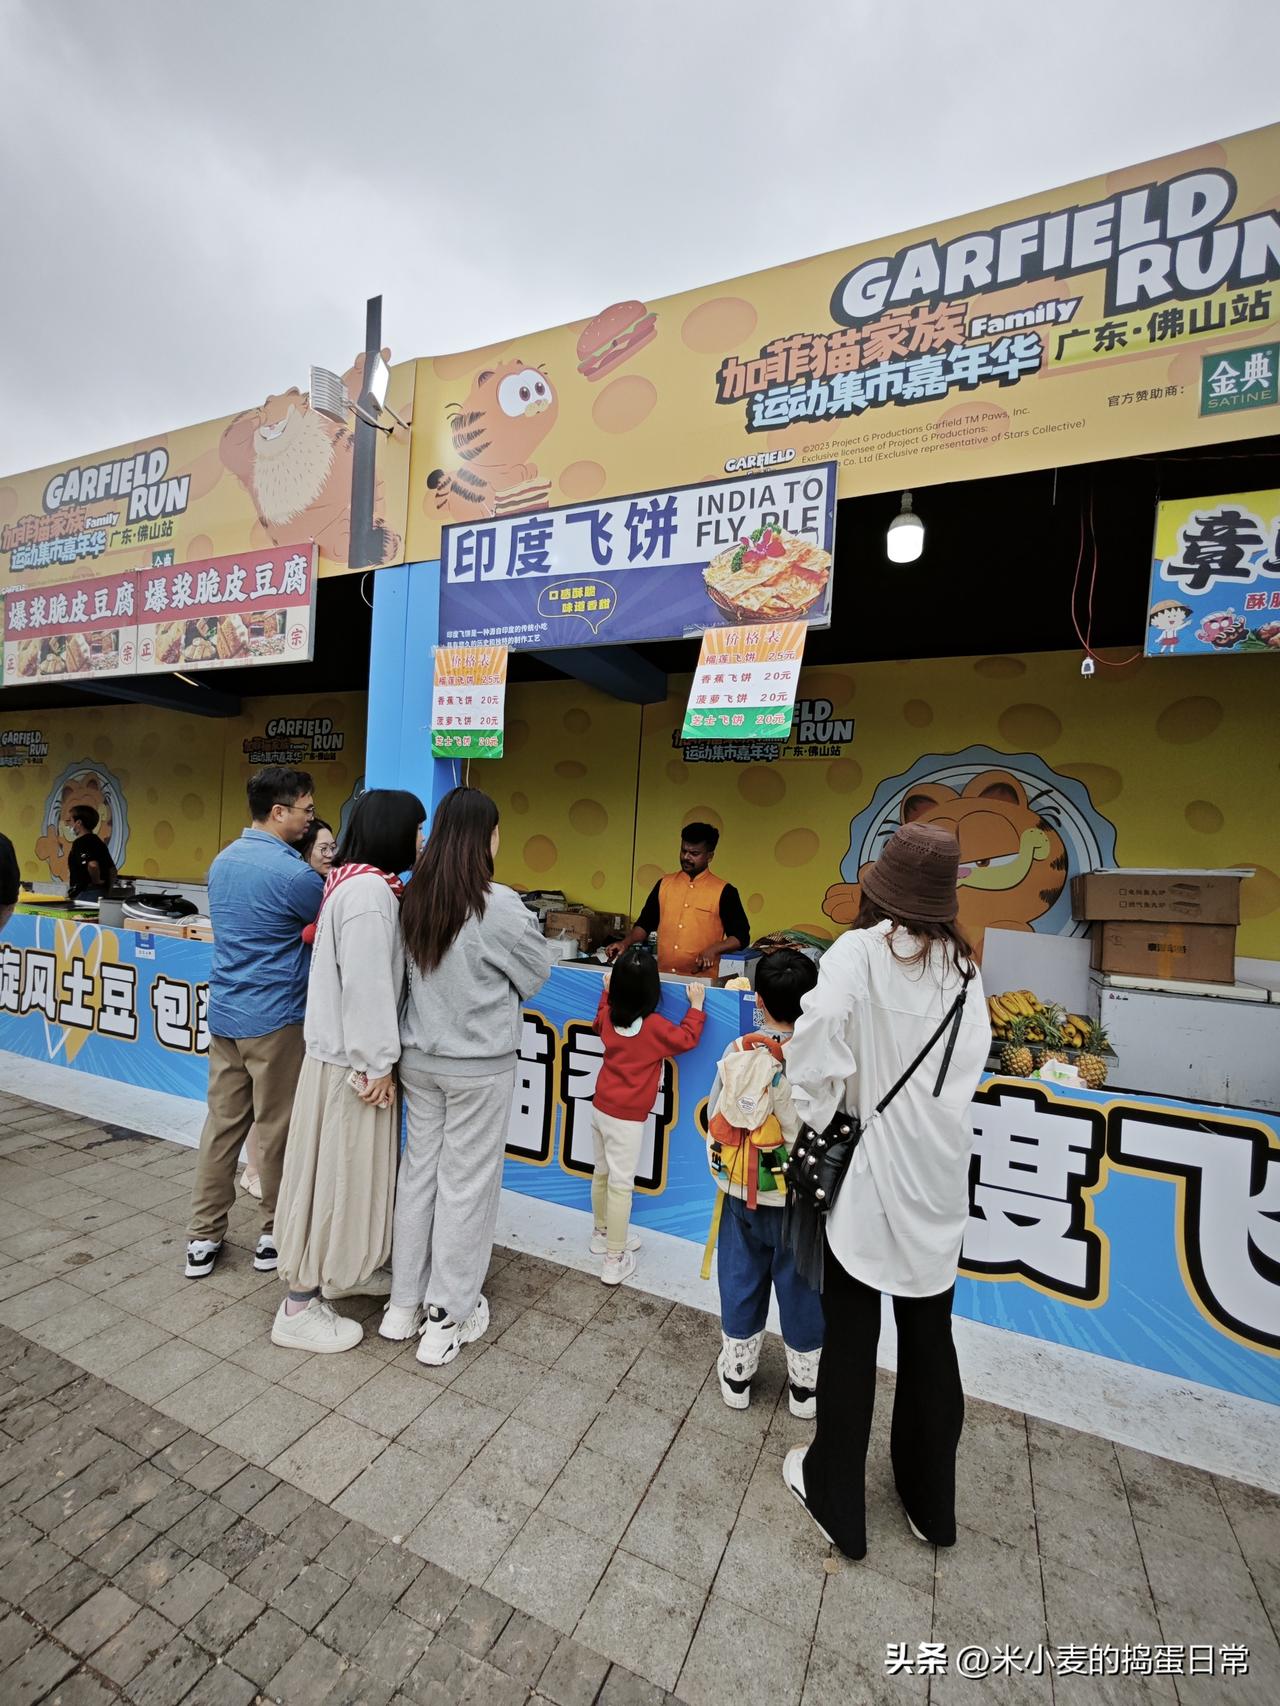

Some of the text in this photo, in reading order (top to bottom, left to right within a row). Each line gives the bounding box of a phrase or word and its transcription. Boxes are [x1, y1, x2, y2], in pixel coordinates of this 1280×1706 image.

[833, 169, 1236, 323] GARFIELD
[1106, 210, 1280, 316] RUN
[971, 297, 1082, 340] Family
[1055, 290, 1272, 360] 广东·佛山站
[718, 302, 968, 402] 加菲猫家族
[748, 332, 1043, 431] 运动集市嘉年华
[1208, 352, 1272, 397] 金典
[1208, 390, 1272, 409] SATINE
[832, 436, 861, 449] Project
[863, 434, 870, 442] G
[872, 425, 923, 441] Productions
[926, 416, 962, 431] Garfield
[965, 415, 979, 425] TM
[982, 410, 1010, 422] Paws,
[1013, 407, 1030, 417] Inc.
[801, 450, 839, 464] Exclusive
[841, 444, 875, 457] licensee
[878, 441, 886, 450] of
[888, 435, 919, 449] Project
[921, 434, 928, 442] G
[930, 425, 988, 441] Productions:
[844, 457, 857, 466] Co.
[859, 454, 873, 464] Ltd
[875, 446, 918, 463] (Exclusive
[920, 435, 989, 453] representative
[991, 433, 1002, 442] of
[1004, 429, 1029, 441] Stars
[1032, 418, 1086, 436] Collective)
[724, 448, 796, 472] GARFIELD
[44, 448, 168, 512] GARFIELD
[127, 475, 191, 524] RUN
[697, 478, 823, 517] INDIA TO
[86, 513, 119, 530] Family
[110, 520, 173, 547] 广东·佛山站
[696, 516, 746, 547] FLY
[454, 496, 678, 577] 印度飞饼
[10, 531, 107, 571] 运动集市嘉年华
[1167, 510, 1280, 589] 章
[144, 554, 309, 613] 爆浆脆皮豆腐
[8, 581, 135, 631] 爆浆脆皮豆腐
[291, 629, 303, 645] 宗
[726, 630, 781, 646] 价格表
[122, 645, 133, 661] 宗
[141, 643, 152, 657] 正
[451, 654, 489, 667] 价格表
[705, 651, 796, 664] 榴莲飞饼 25元
[482, 674, 500, 684] 25元
[701, 671, 791, 684] 香蕉飞饼 20元
[438, 695, 499, 705] 香蕉飞饼 20元
[696, 692, 788, 705] 菠萝飞饼 20元
[266, 718, 333, 738] GARFIELD
[480, 716, 499, 726] 20元
[691, 714, 786, 727] 芝士飞饼 20元
[797, 719, 854, 744] RUN
[1, 730, 42, 746] GARFIELD
[29, 743, 48, 757] RUN
[312, 732, 344, 751] RUN
[435, 736, 499, 747] 芝士飞饼 20元
[684, 745, 779, 762] 运动集市嘉年华
